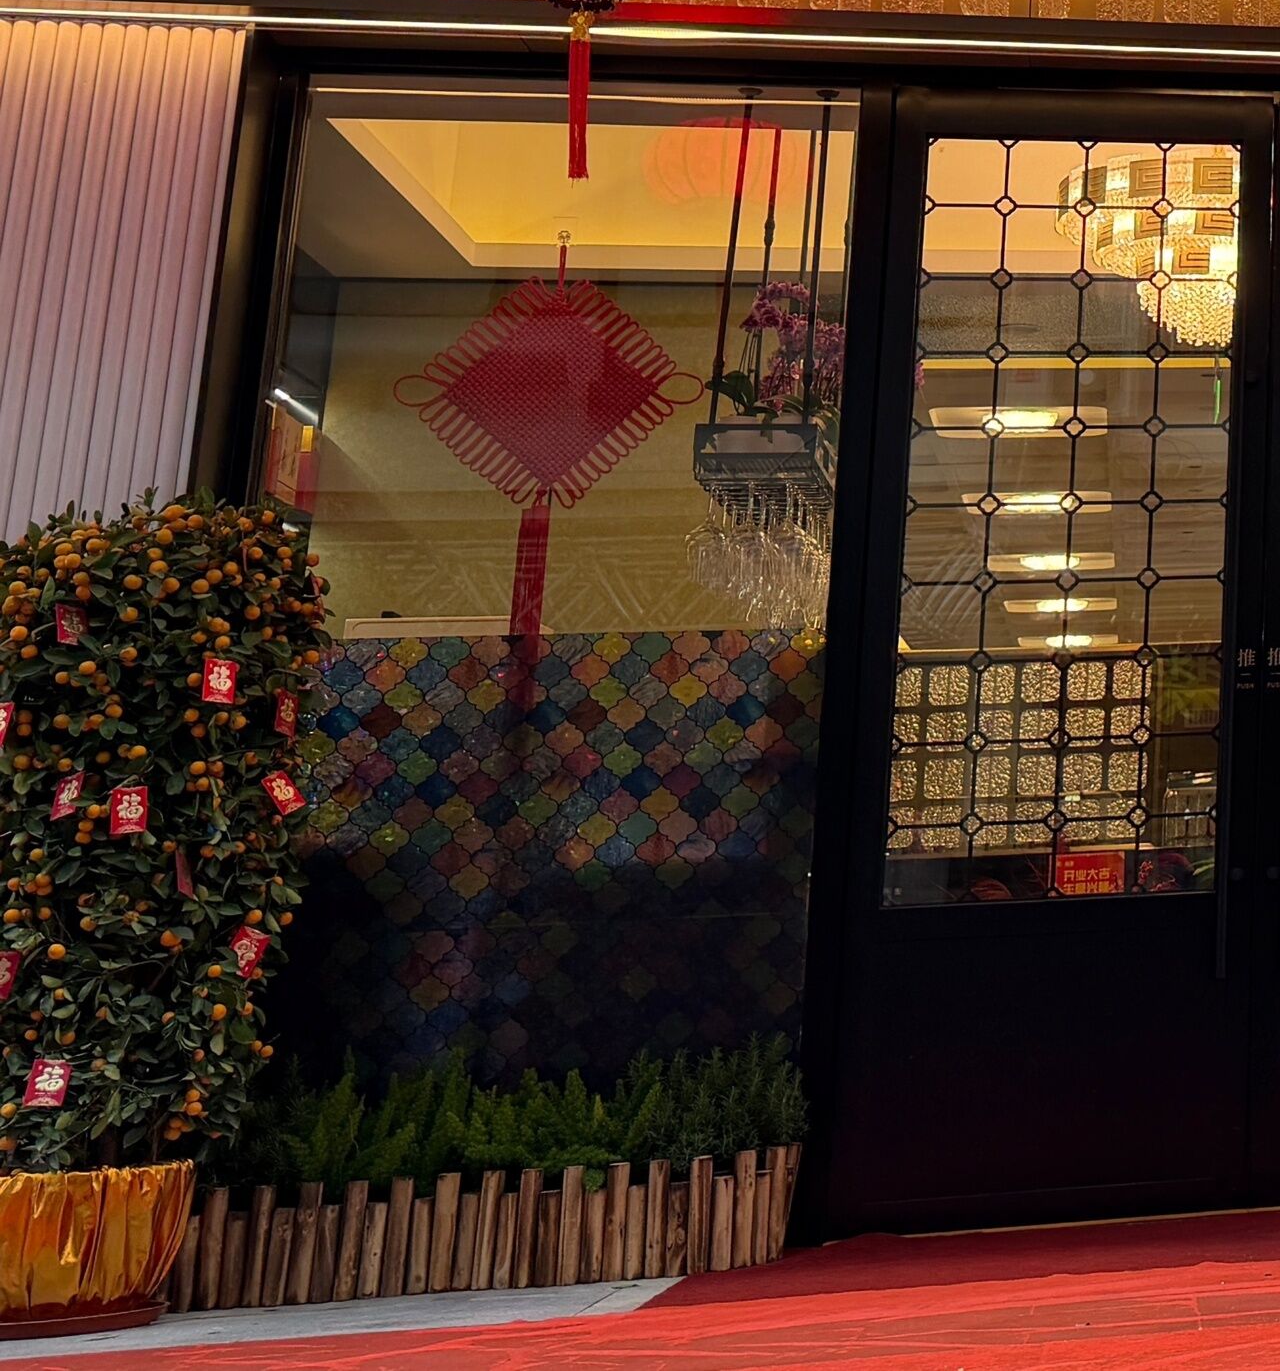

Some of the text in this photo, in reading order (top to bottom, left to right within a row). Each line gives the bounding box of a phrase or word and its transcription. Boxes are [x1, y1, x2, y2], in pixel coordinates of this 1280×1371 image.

[1237, 648, 1255, 667] 推
[208, 666, 232, 691] 福
[272, 778, 294, 802] 福
[117, 793, 144, 819] 福
[1064, 868, 1110, 881] 开业大吉
[35, 1066, 64, 1092] 福
